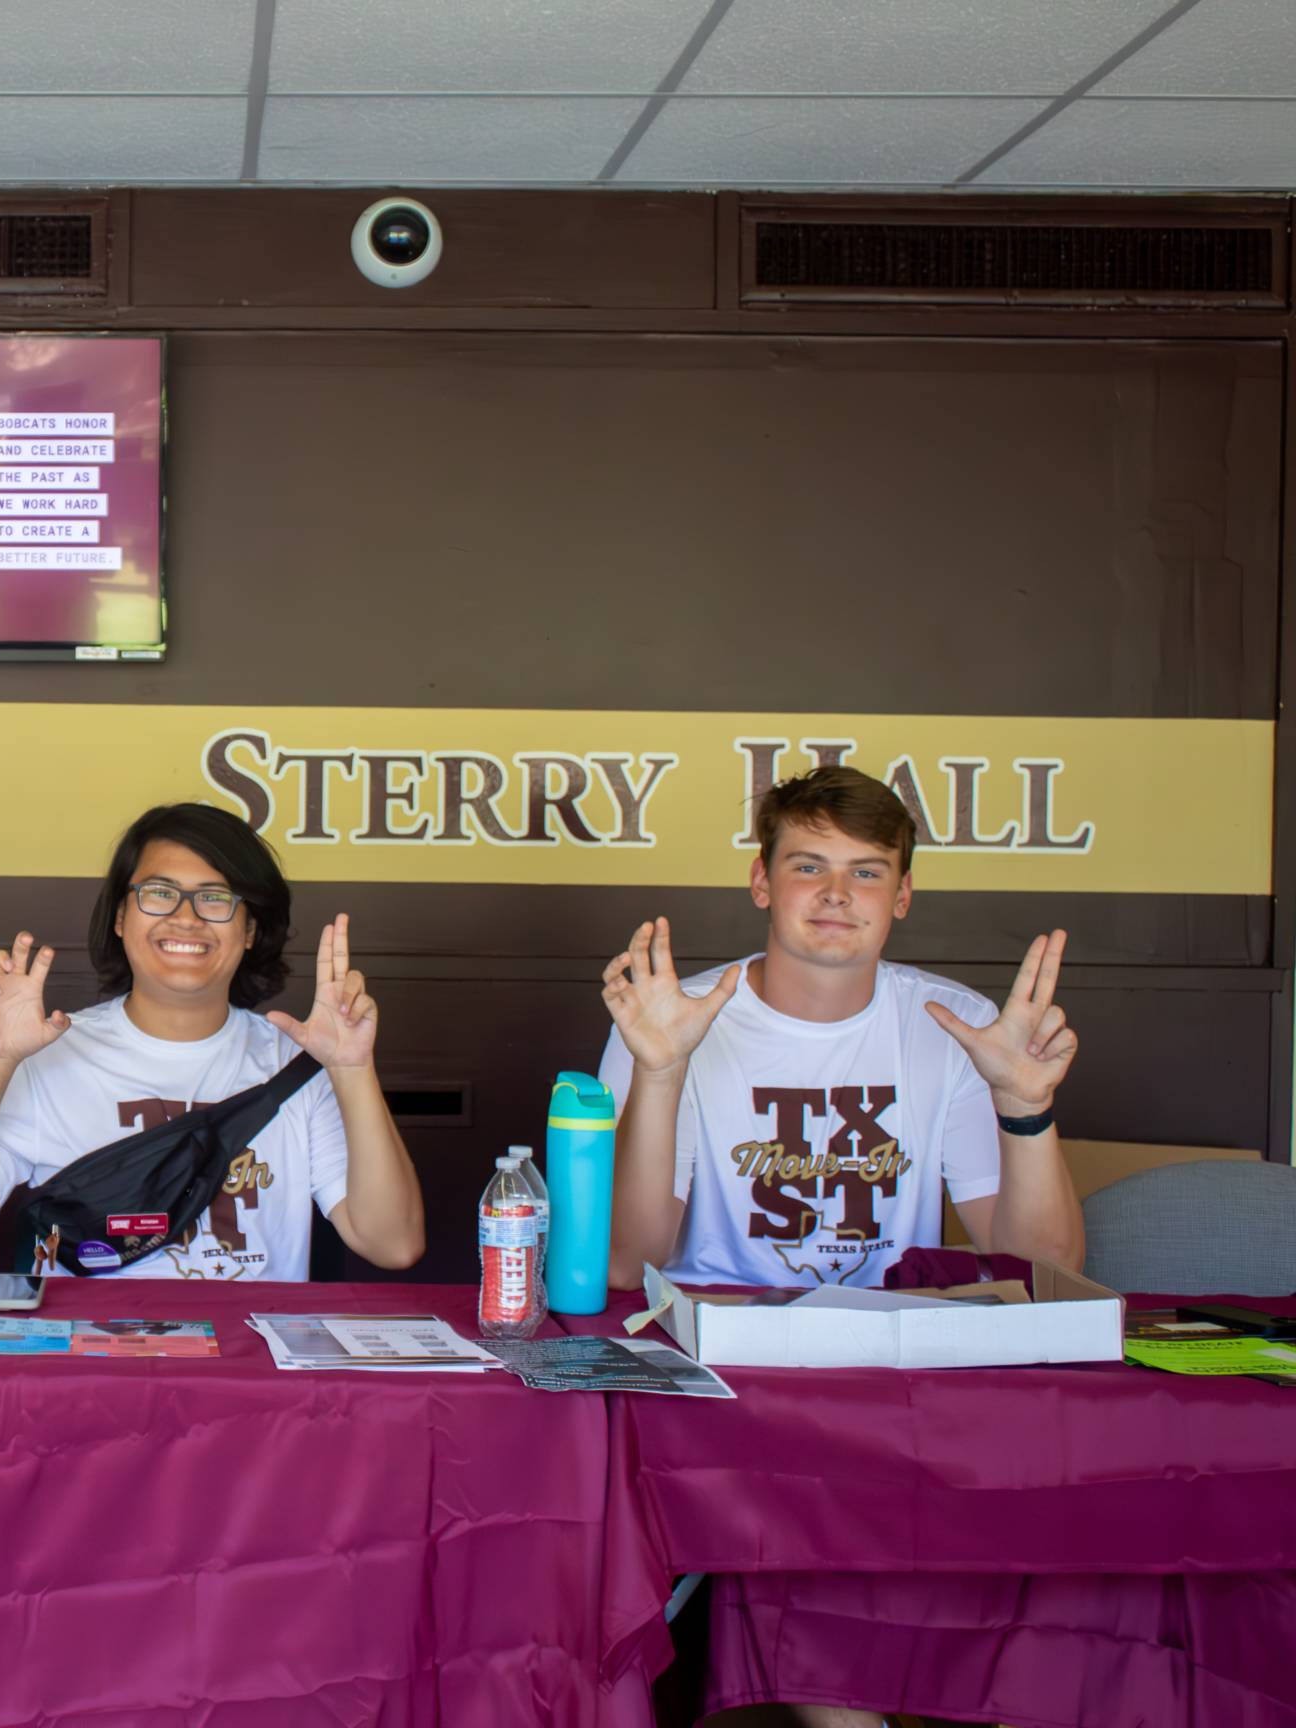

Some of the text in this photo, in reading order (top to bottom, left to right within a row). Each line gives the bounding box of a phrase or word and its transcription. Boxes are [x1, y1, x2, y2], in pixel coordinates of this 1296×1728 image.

[65, 418, 108, 429] HONOR
[30, 445, 107, 456] CELEBRATE
[31, 471, 65, 482] PAST
[73, 471, 90, 483] AS
[22, 499, 56, 509] WORK
[65, 499, 99, 509] HARD
[22, 525, 72, 536] CREATE
[81, 525, 90, 536] A
[56, 552, 113, 563] FUTURE.
[202, 729, 678, 846] STERRY
[752, 1085, 898, 1158] TX
[730, 1140, 912, 1188] Move-In
[749, 1172, 897, 1241] ST
[816, 1239, 895, 1254] TEXAS STATE
